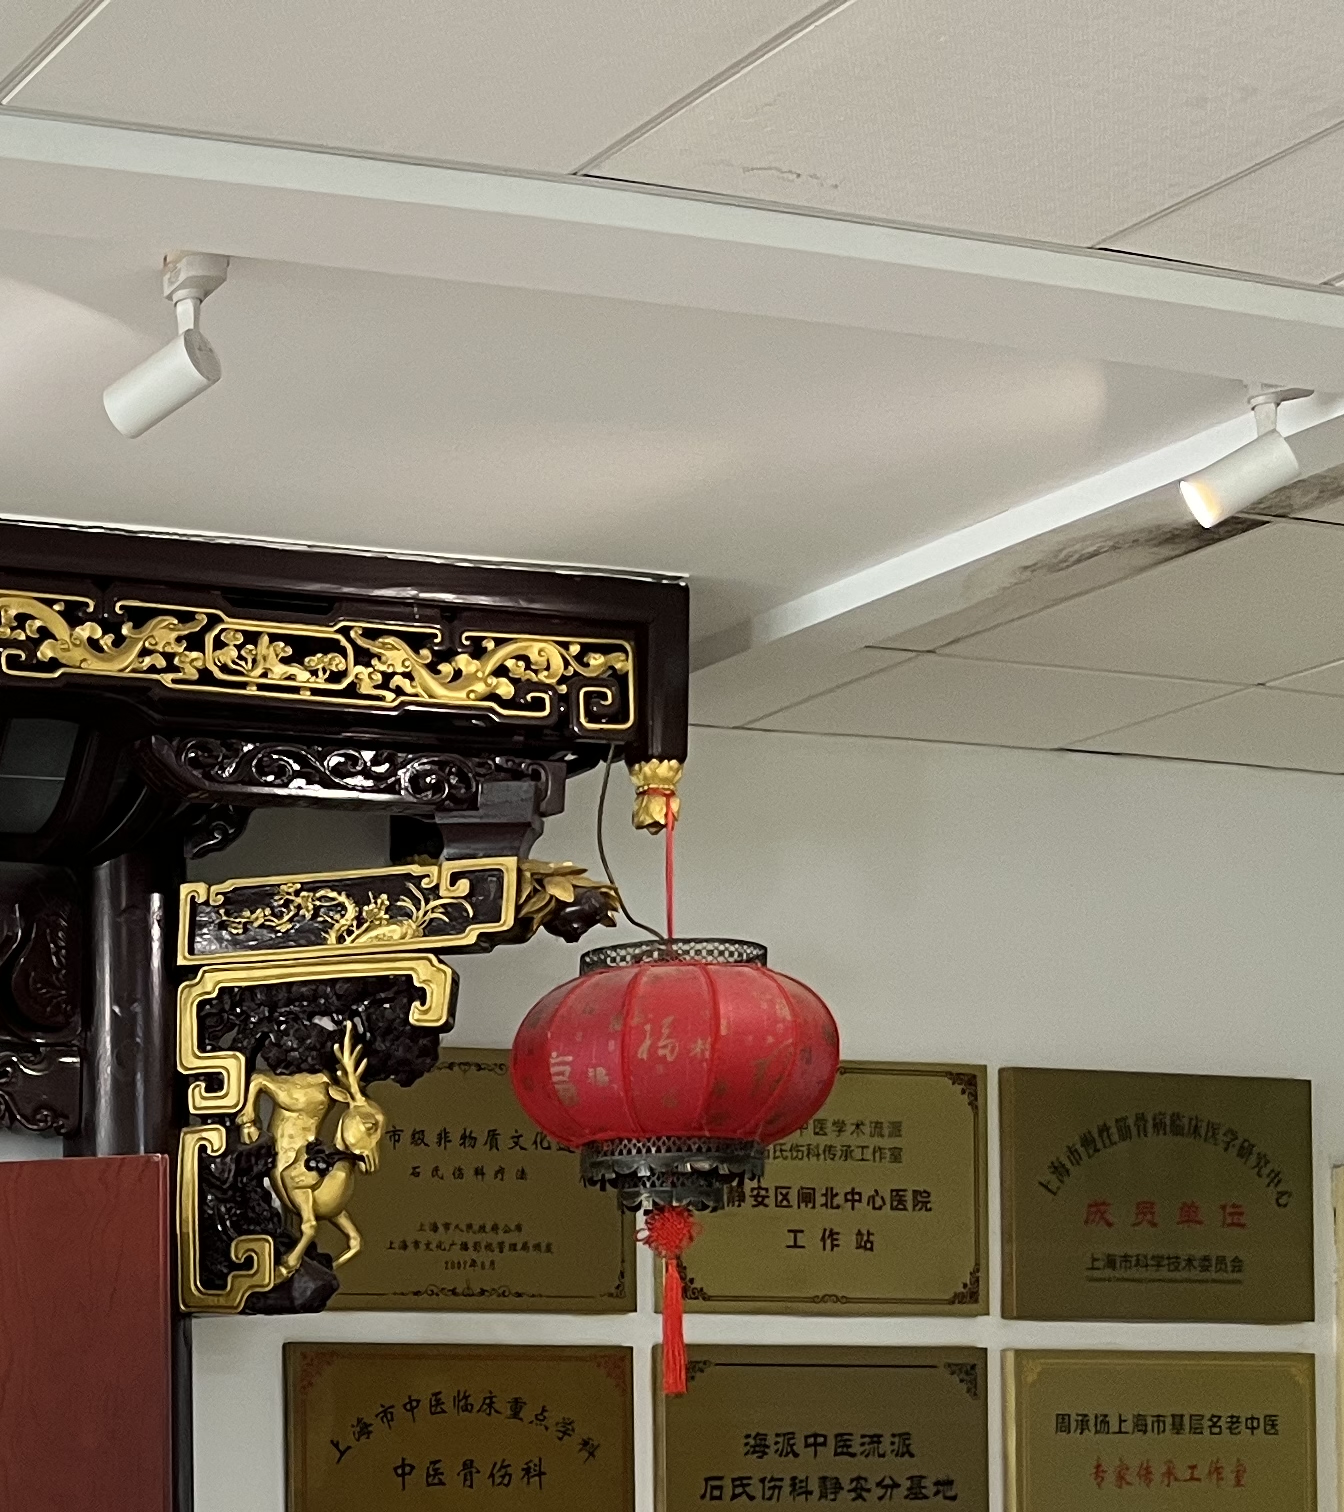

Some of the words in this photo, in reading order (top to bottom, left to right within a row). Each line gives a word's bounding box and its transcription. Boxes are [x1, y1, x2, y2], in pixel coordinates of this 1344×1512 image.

[765, 1143, 904, 1164] 氏伤科传承工作室
[726, 1185, 934, 1213] 静安区闸北中心医院
[1083, 1199, 1249, 1230] 成员单位
[785, 1227, 876, 1252] 工作站
[1085, 1252, 1246, 1275] 上海市科学技术委员会
[329, 1388, 601, 1465] 上海市中医临床重点学科
[742, 1431, 917, 1460] 海派中医流派
[392, 1456, 549, 1492] 中医骨伤科
[1090, 1455, 1249, 1490] 专家传承工作室
[699, 1474, 960, 1503] 石氏伤科静安分基地
